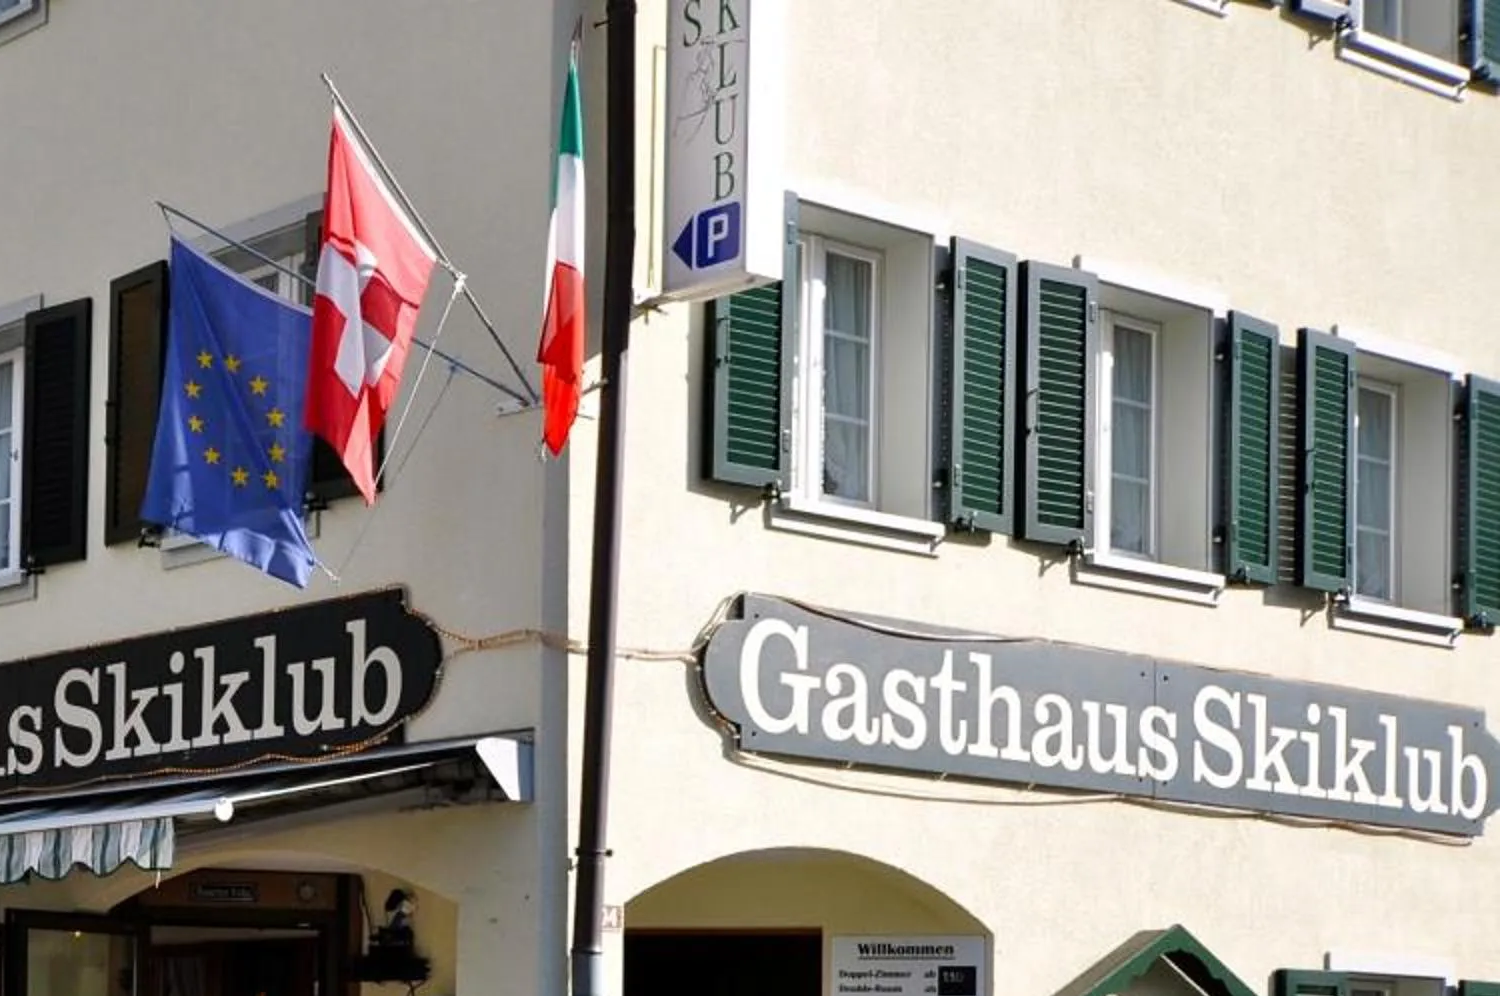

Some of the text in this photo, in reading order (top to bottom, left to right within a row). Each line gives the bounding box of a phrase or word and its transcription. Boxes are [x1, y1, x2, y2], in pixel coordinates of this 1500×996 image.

[707, 214, 729, 258] P
[52, 619, 403, 768] Skiklub
[739, 618, 1488, 821] Gasthaus Skiklub
[856, 943, 955, 956] Willkommen
